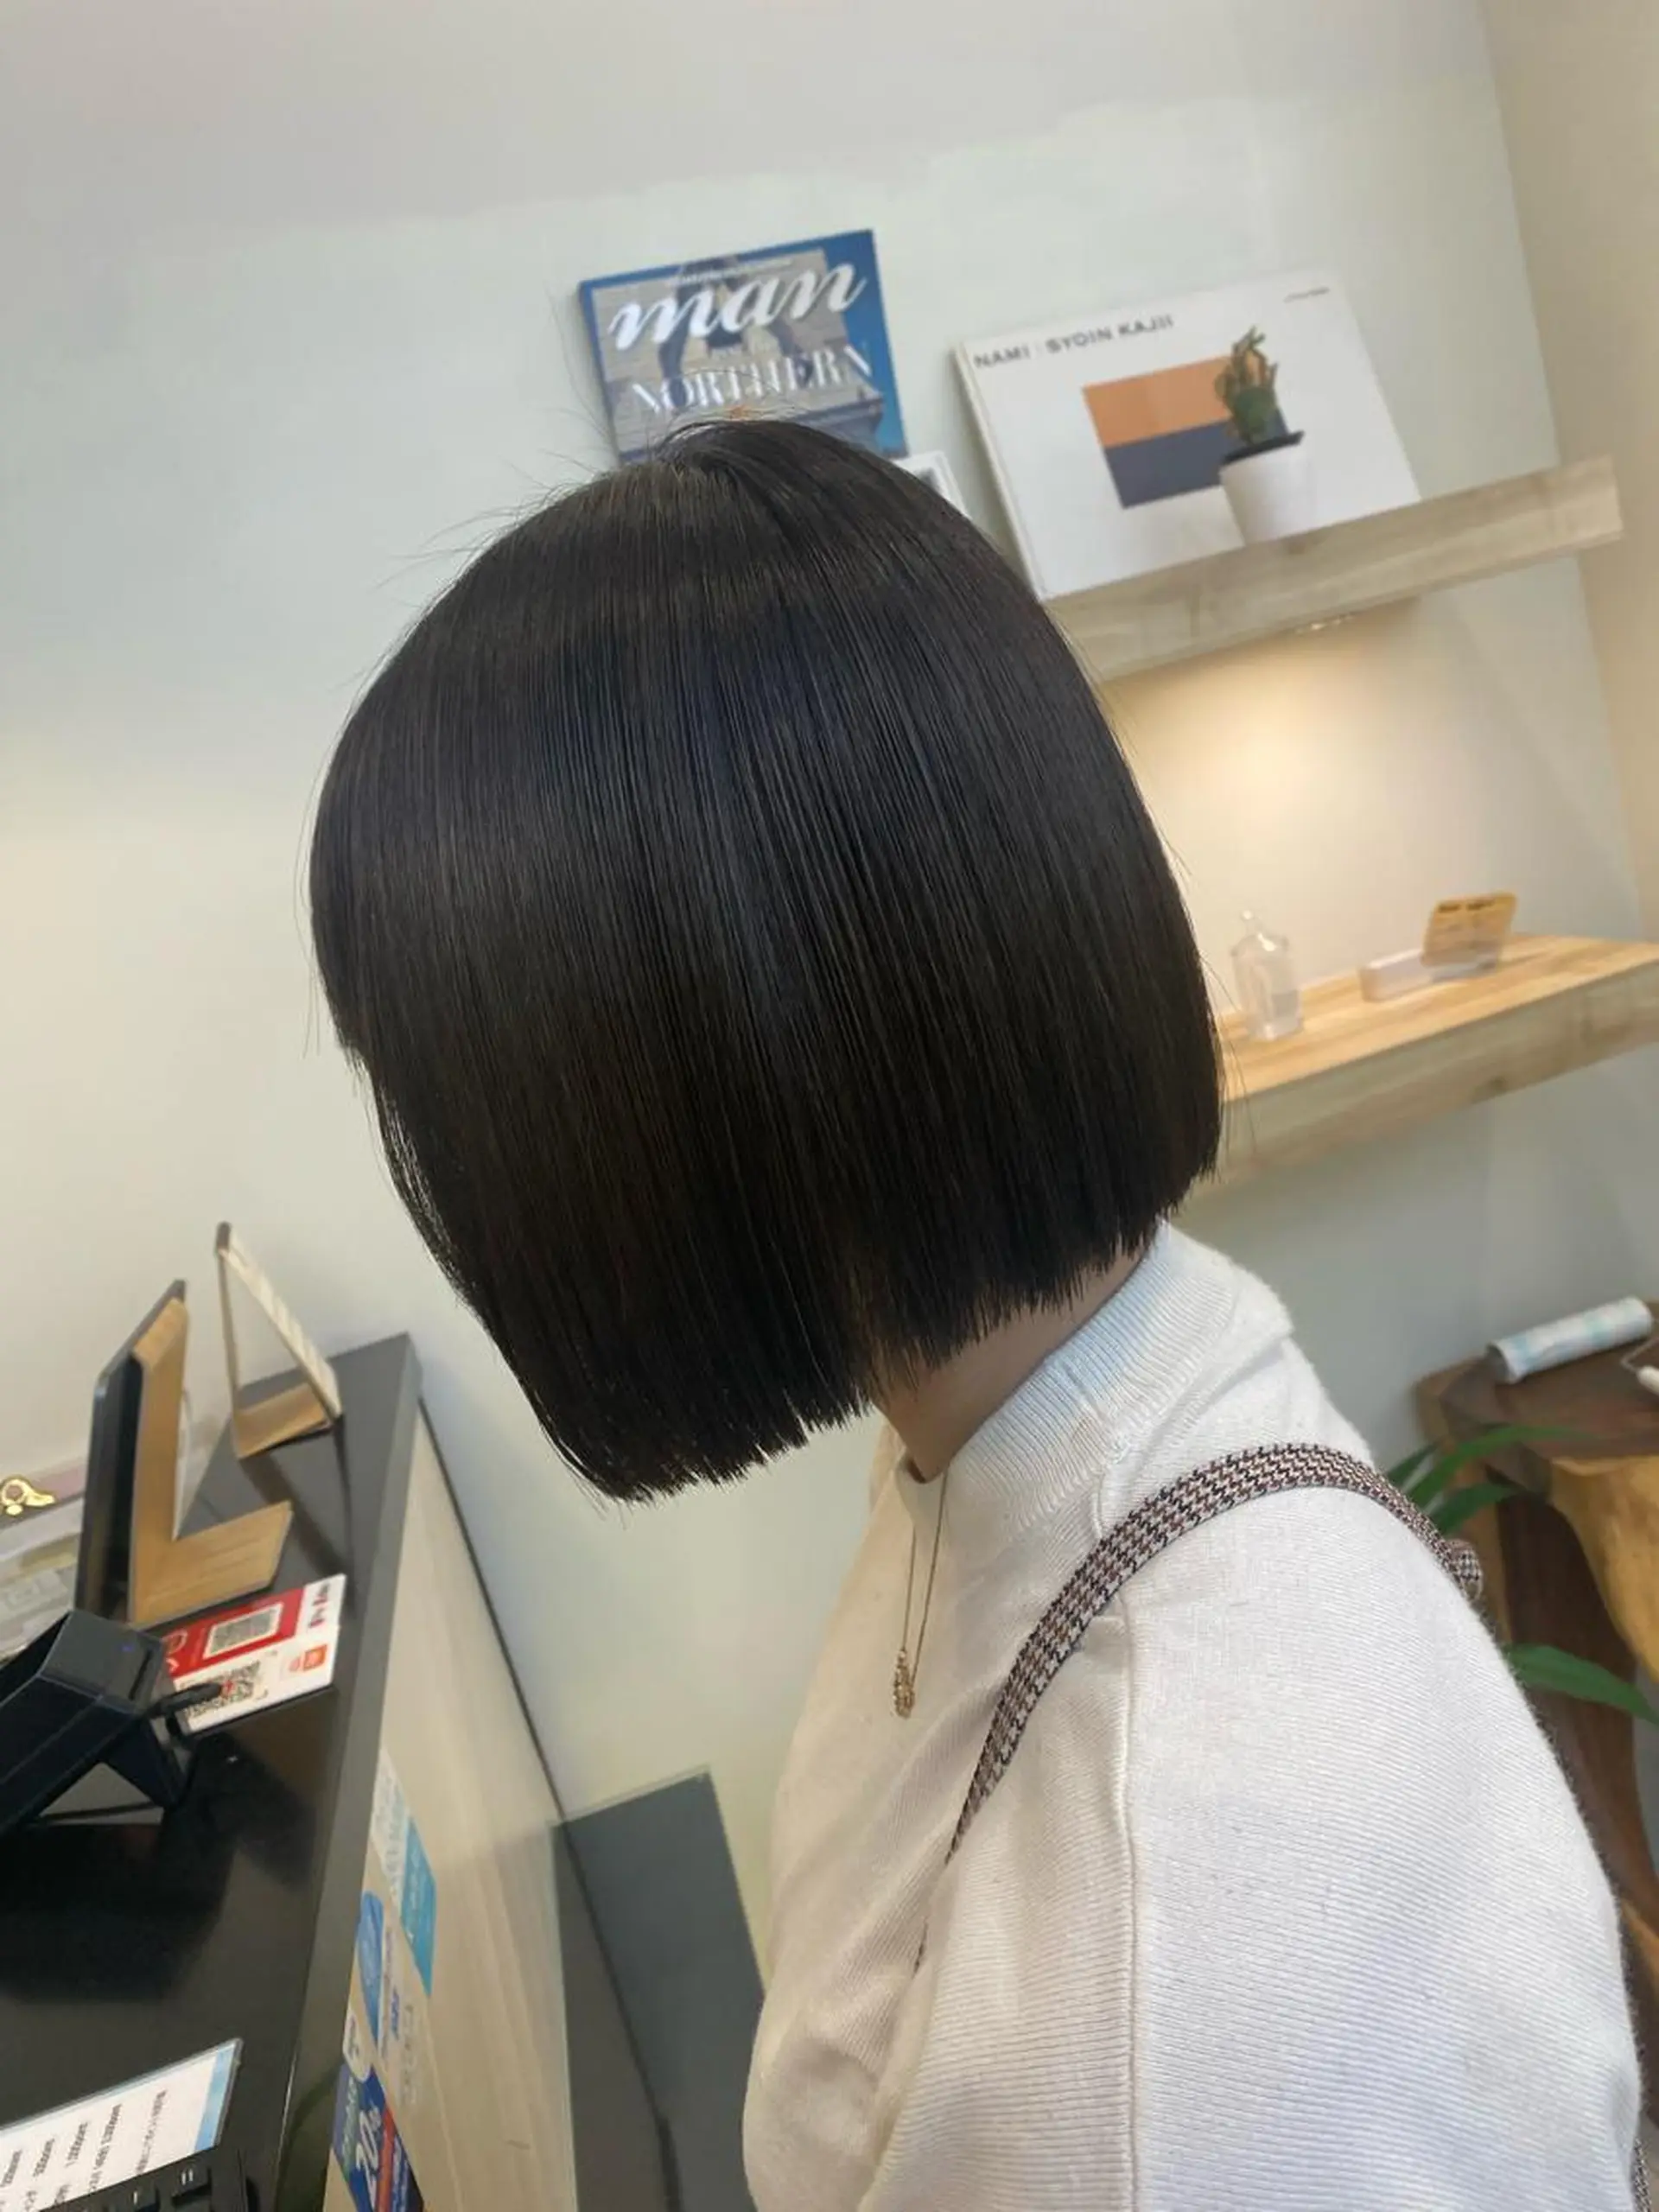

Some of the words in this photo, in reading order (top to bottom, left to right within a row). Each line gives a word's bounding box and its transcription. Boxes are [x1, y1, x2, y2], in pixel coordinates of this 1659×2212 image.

[607, 264, 868, 351] man
[632, 346, 872, 415] NORTHERN
[974, 345, 1030, 368] NAMI
